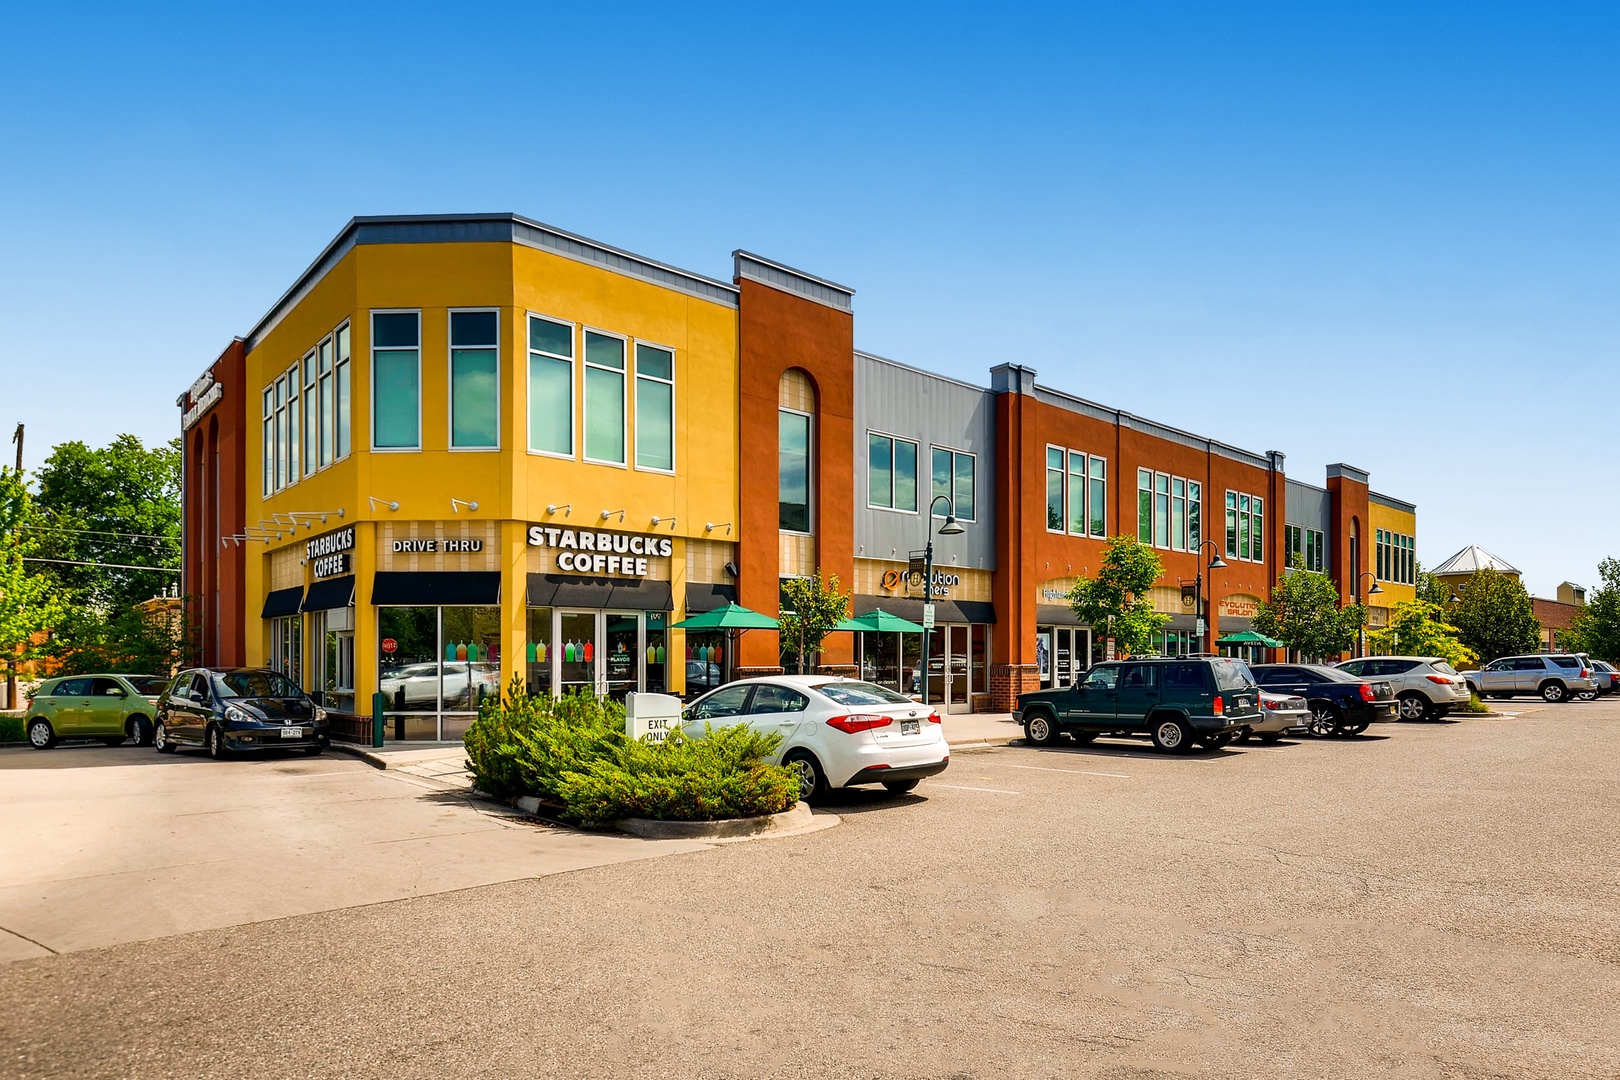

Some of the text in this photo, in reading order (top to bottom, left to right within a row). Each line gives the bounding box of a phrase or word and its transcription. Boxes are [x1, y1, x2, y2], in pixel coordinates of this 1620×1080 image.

[306, 528, 353, 560] STARBUCKS
[393, 540, 480, 552] DRIVE THRU
[528, 526, 672, 557] STARBUCKS
[314, 554, 343, 578] COFFEE
[557, 551, 648, 576] COFFEE
[1218, 600, 1257, 610] EVOLUTIO
[648, 720, 667, 729] EXIT
[646, 732, 669, 742] ONLY
